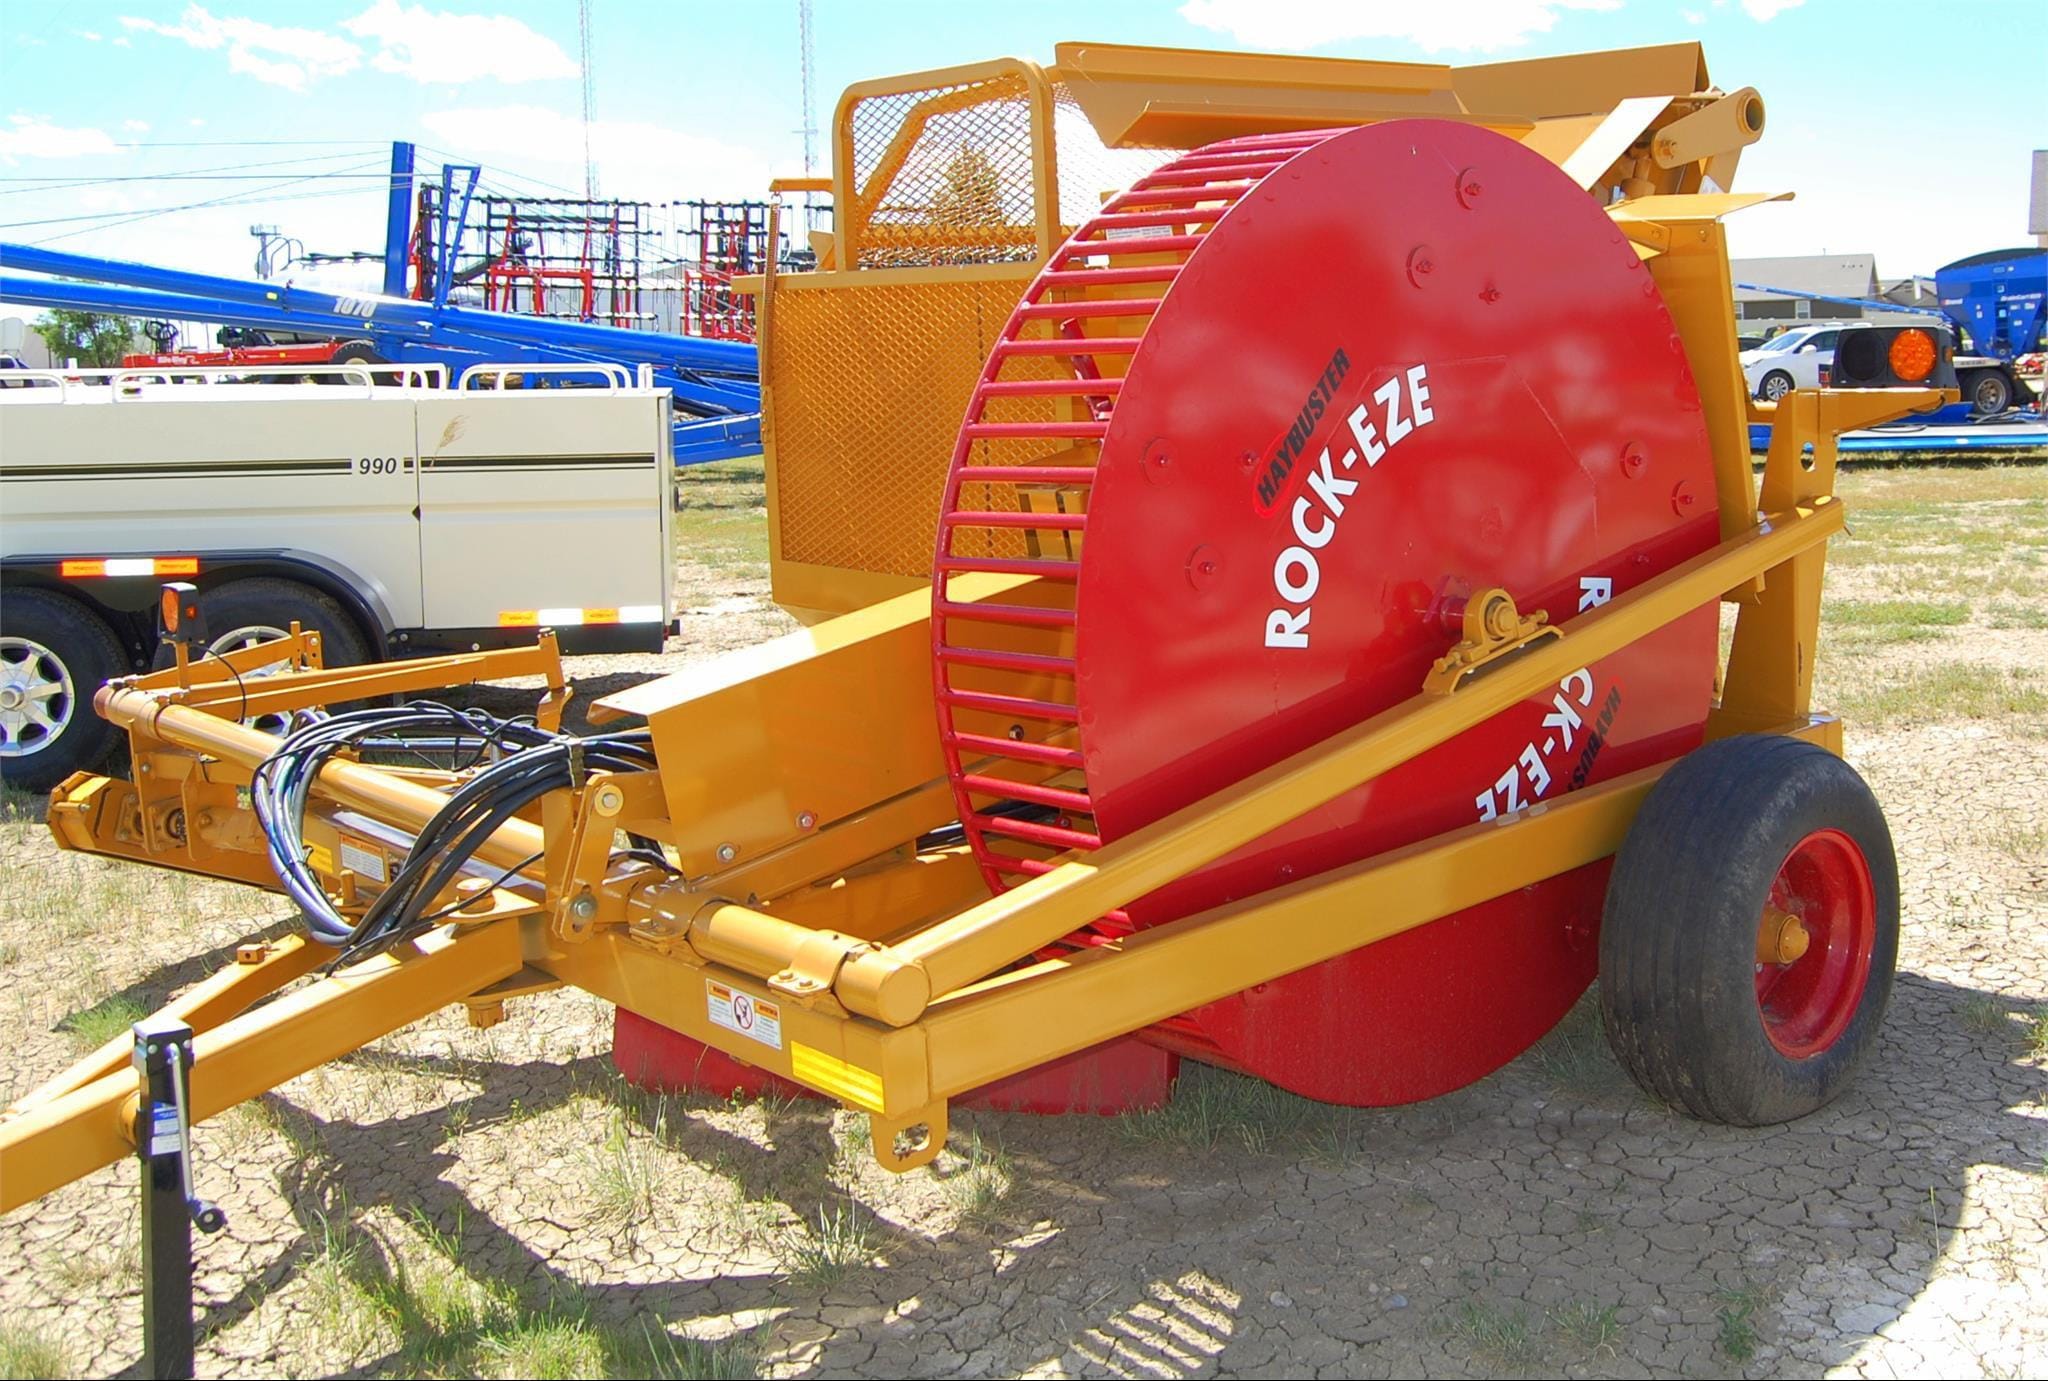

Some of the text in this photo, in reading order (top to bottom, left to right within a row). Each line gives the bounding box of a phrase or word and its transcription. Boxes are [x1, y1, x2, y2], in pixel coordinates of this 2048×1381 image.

[333, 296, 377, 318] 1070
[359, 457, 397, 475] 990
[1257, 347, 1350, 507] HAYBUSTER
[1264, 363, 1435, 649] ROCK-EZE
[1475, 576, 1613, 823] RCK-EZE
